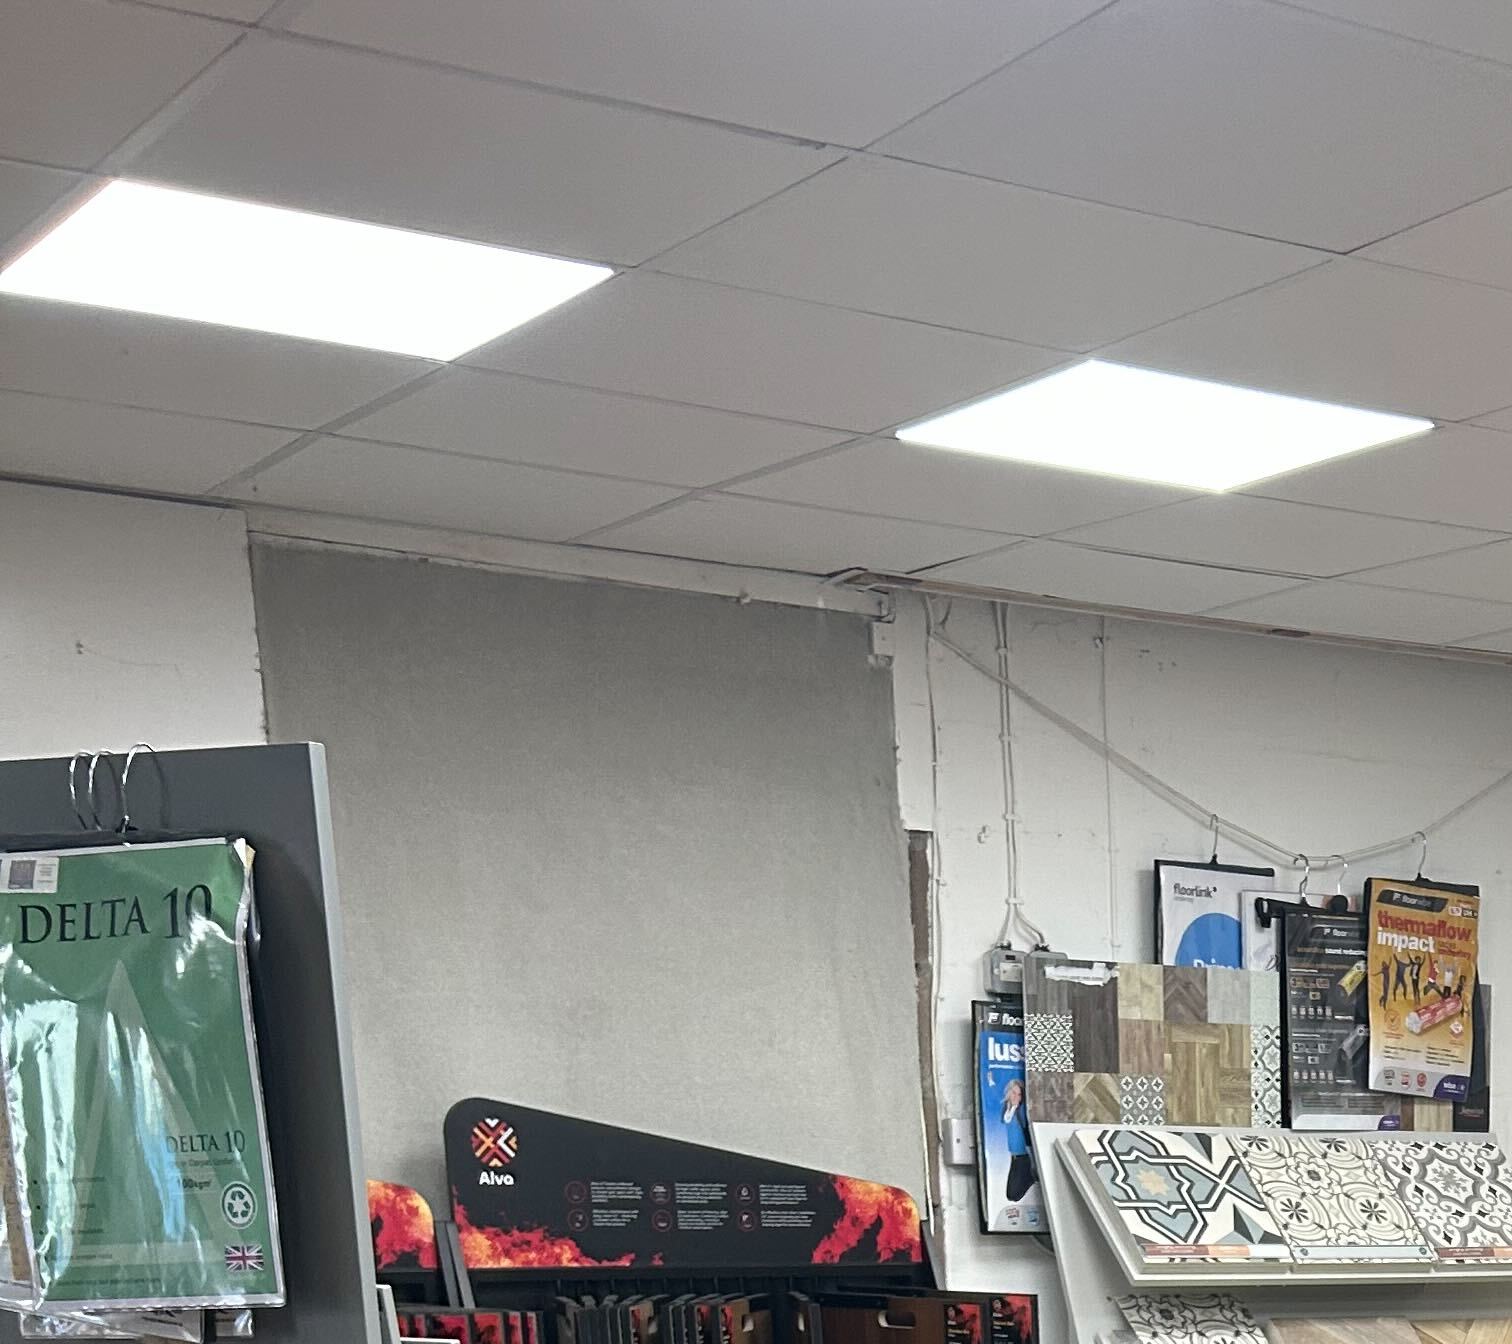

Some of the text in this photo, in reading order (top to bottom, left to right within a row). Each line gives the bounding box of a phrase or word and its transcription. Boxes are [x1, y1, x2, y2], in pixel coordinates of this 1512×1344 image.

[18, 895, 151, 945] DELTA
[1377, 926, 1435, 953] impact
[166, 1129, 246, 1154] DELTA 10
[479, 1171, 515, 1186] Alva
